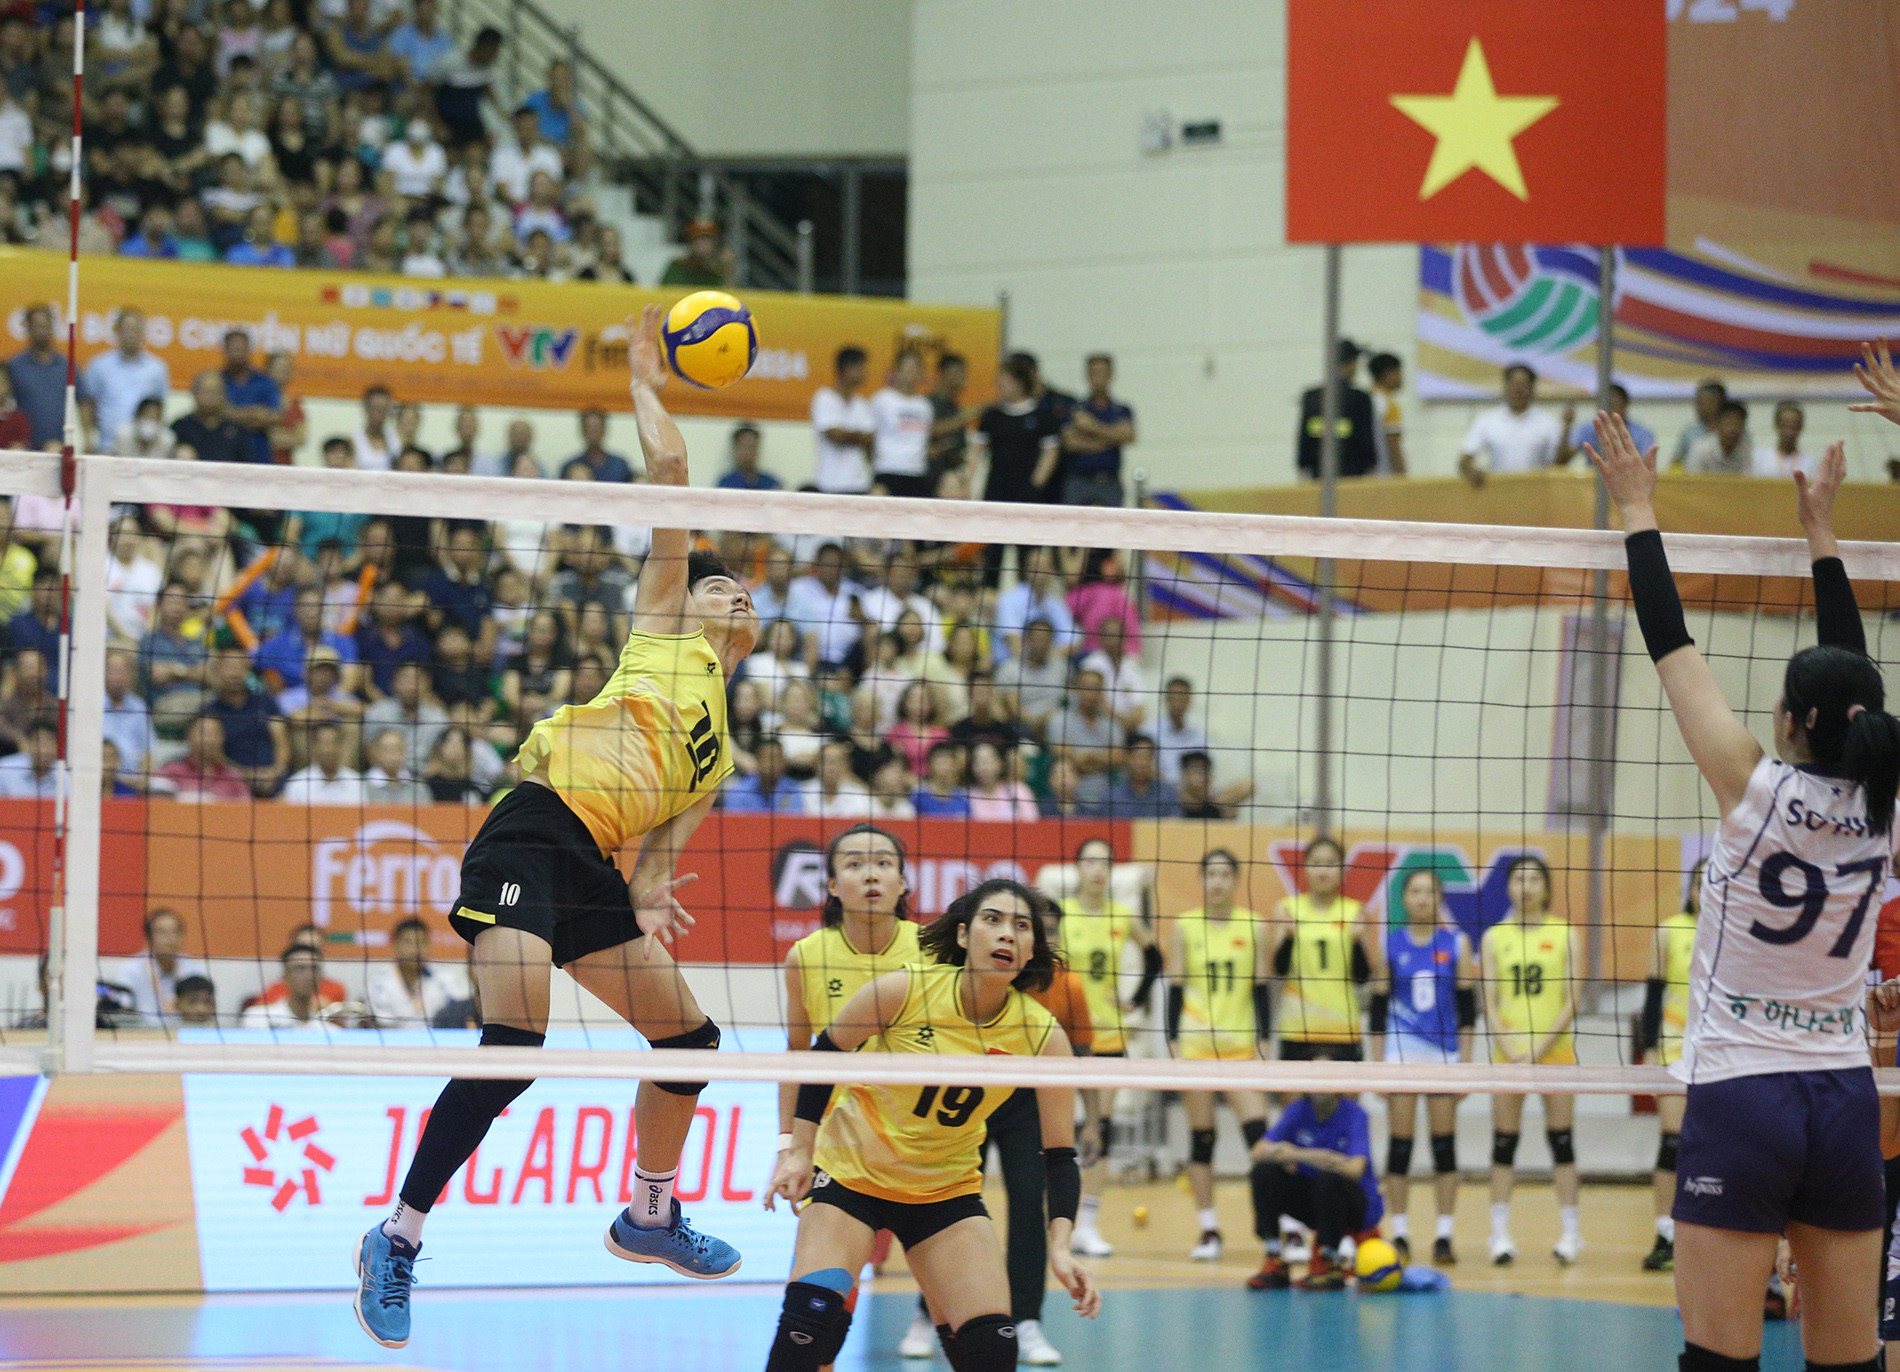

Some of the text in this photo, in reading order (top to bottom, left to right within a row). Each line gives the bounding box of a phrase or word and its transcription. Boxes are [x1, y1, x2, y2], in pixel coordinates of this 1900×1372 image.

[499, 326, 580, 371] VTV
[312, 836, 470, 928] Ferro
[498, 882, 521, 906] 10
[1750, 851, 1888, 958] 97
[1317, 940, 1327, 969] 1
[1206, 961, 1234, 993] 11
[913, 1086, 985, 1127] 19
[363, 1106, 754, 1206] JGAROL
